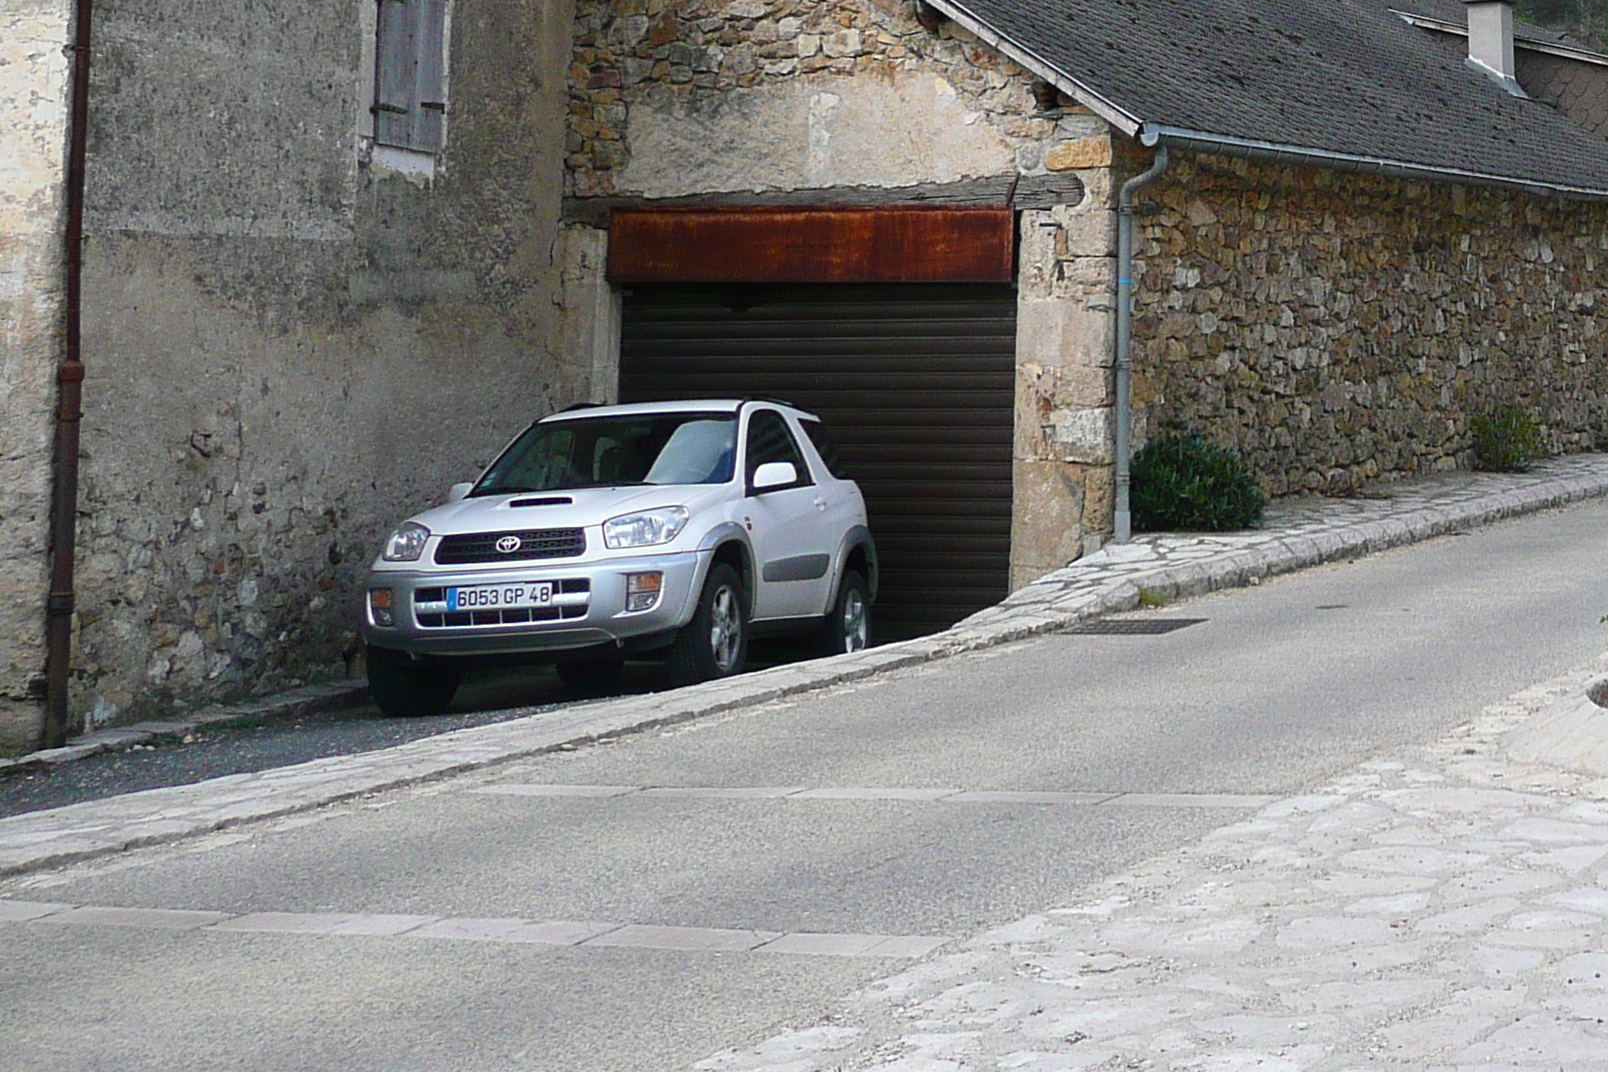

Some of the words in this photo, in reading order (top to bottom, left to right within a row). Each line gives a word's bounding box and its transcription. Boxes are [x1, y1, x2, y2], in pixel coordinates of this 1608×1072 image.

[457, 589, 499, 607] 6053
[503, 588, 524, 604] GP
[529, 586, 550, 603] 48
